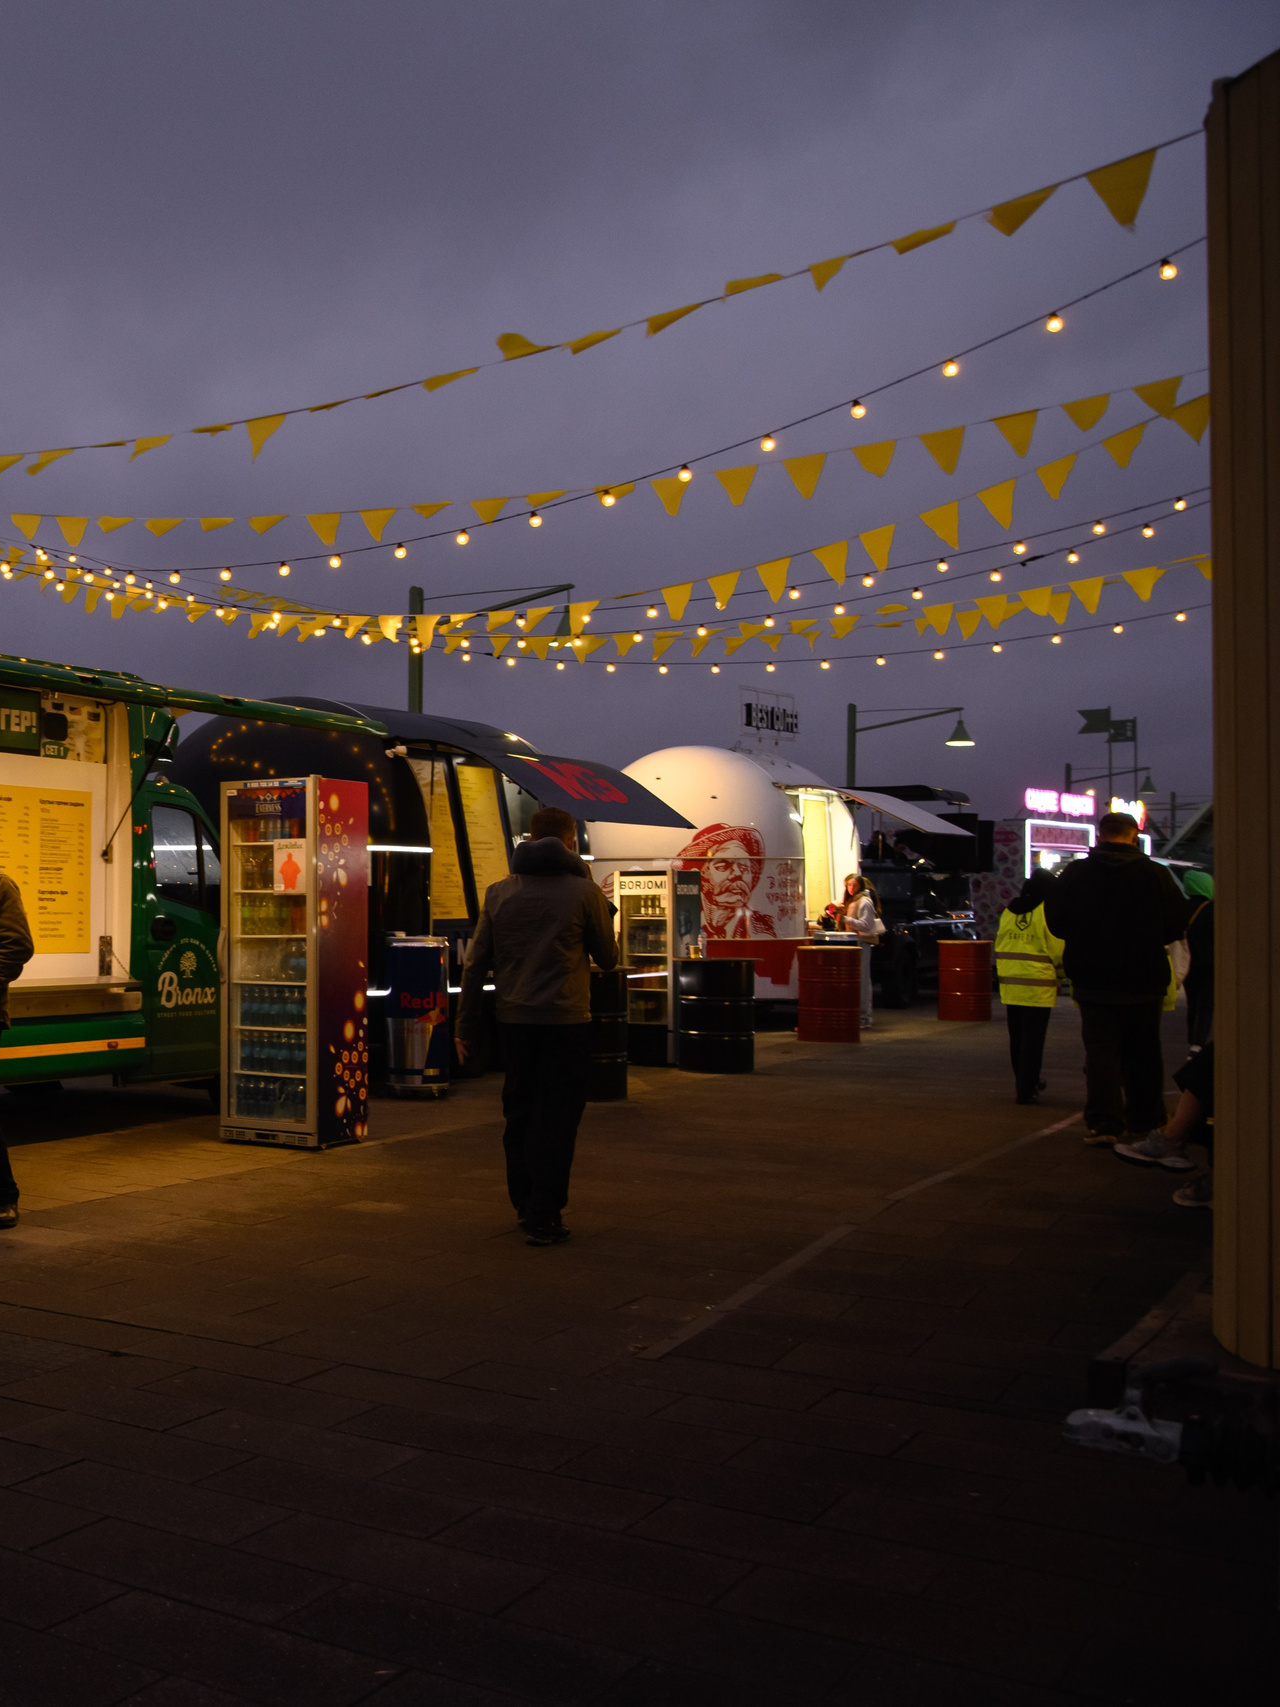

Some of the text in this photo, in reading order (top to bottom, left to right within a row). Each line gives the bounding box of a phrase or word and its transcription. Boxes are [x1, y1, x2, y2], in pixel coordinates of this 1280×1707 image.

[620, 880, 667, 890] BORJOMI
[1008, 932, 1036, 942] SAFETY
[158, 970, 217, 1009] Bronx
[399, 992, 435, 1009] Red
